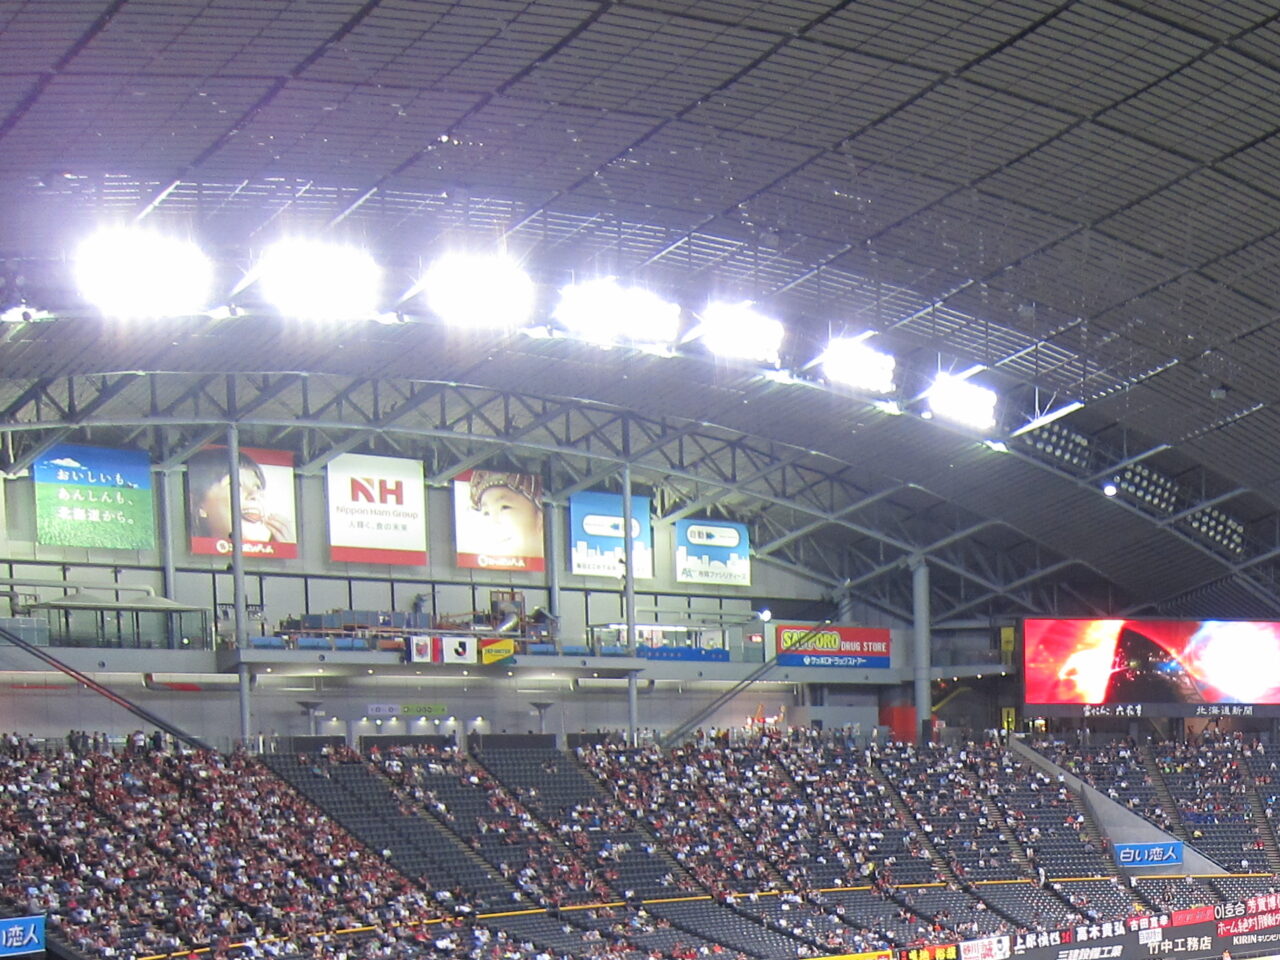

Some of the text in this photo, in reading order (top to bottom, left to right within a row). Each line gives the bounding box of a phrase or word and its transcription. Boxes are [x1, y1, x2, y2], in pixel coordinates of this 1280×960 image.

[336, 506, 418, 520] Nippon Ham Group
[782, 631, 887, 653] SAPPORO DRUG STORE
[1196, 706, 1254, 716] 北海道新聞
[1119, 846, 1178, 863] 白い恋人
[1148, 936, 1212, 955] 竹中工務店
[1233, 934, 1257, 946] KIRIN
